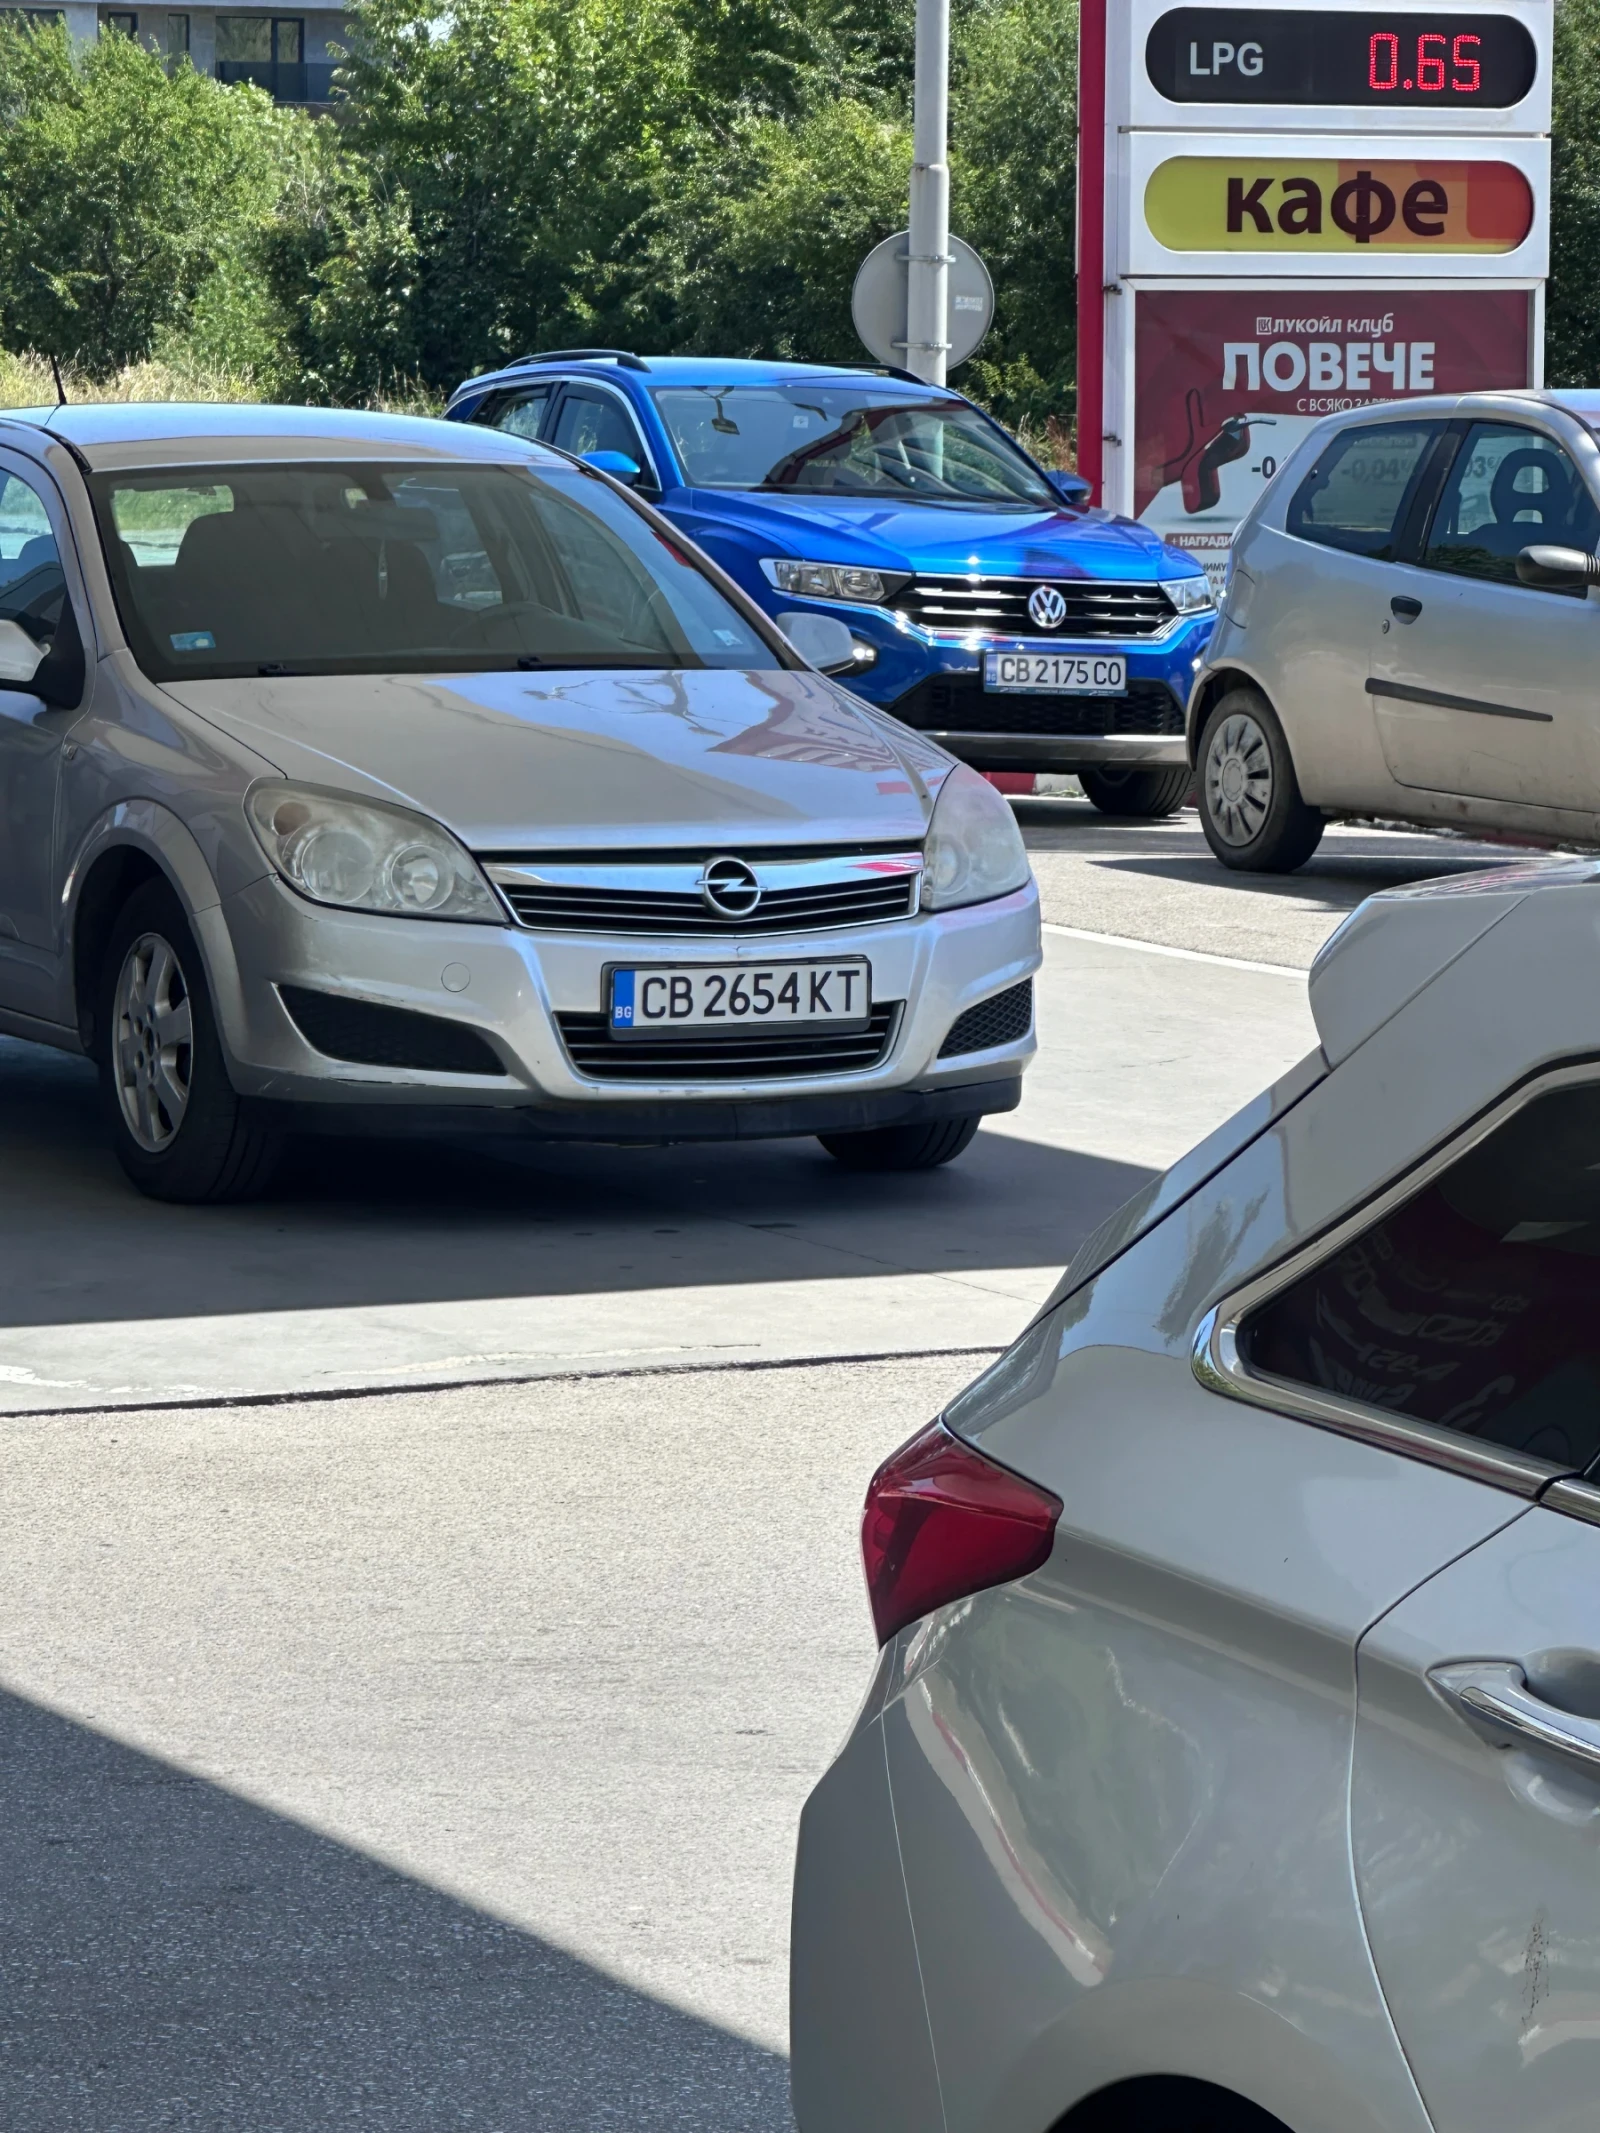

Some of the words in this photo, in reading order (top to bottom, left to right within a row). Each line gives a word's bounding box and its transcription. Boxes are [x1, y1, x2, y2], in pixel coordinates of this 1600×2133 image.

[1189, 42, 1264, 77] LPG
[1368, 33, 1482, 91] 0.65
[1226, 170, 1449, 244] кафе
[1347, 313, 1394, 338] клуб
[1222, 341, 1435, 392] ПОВЕЧЕ
[1296, 398, 1306, 412] С
[1251, 456, 1277, 479] -0
[1000, 657, 1030, 683] CB
[1035, 659, 1089, 684] 2175
[615, 1006, 632, 1019] BG
[641, 976, 694, 1020] CB
[703, 972, 800, 1018] 2654
[809, 970, 860, 1013] KT
